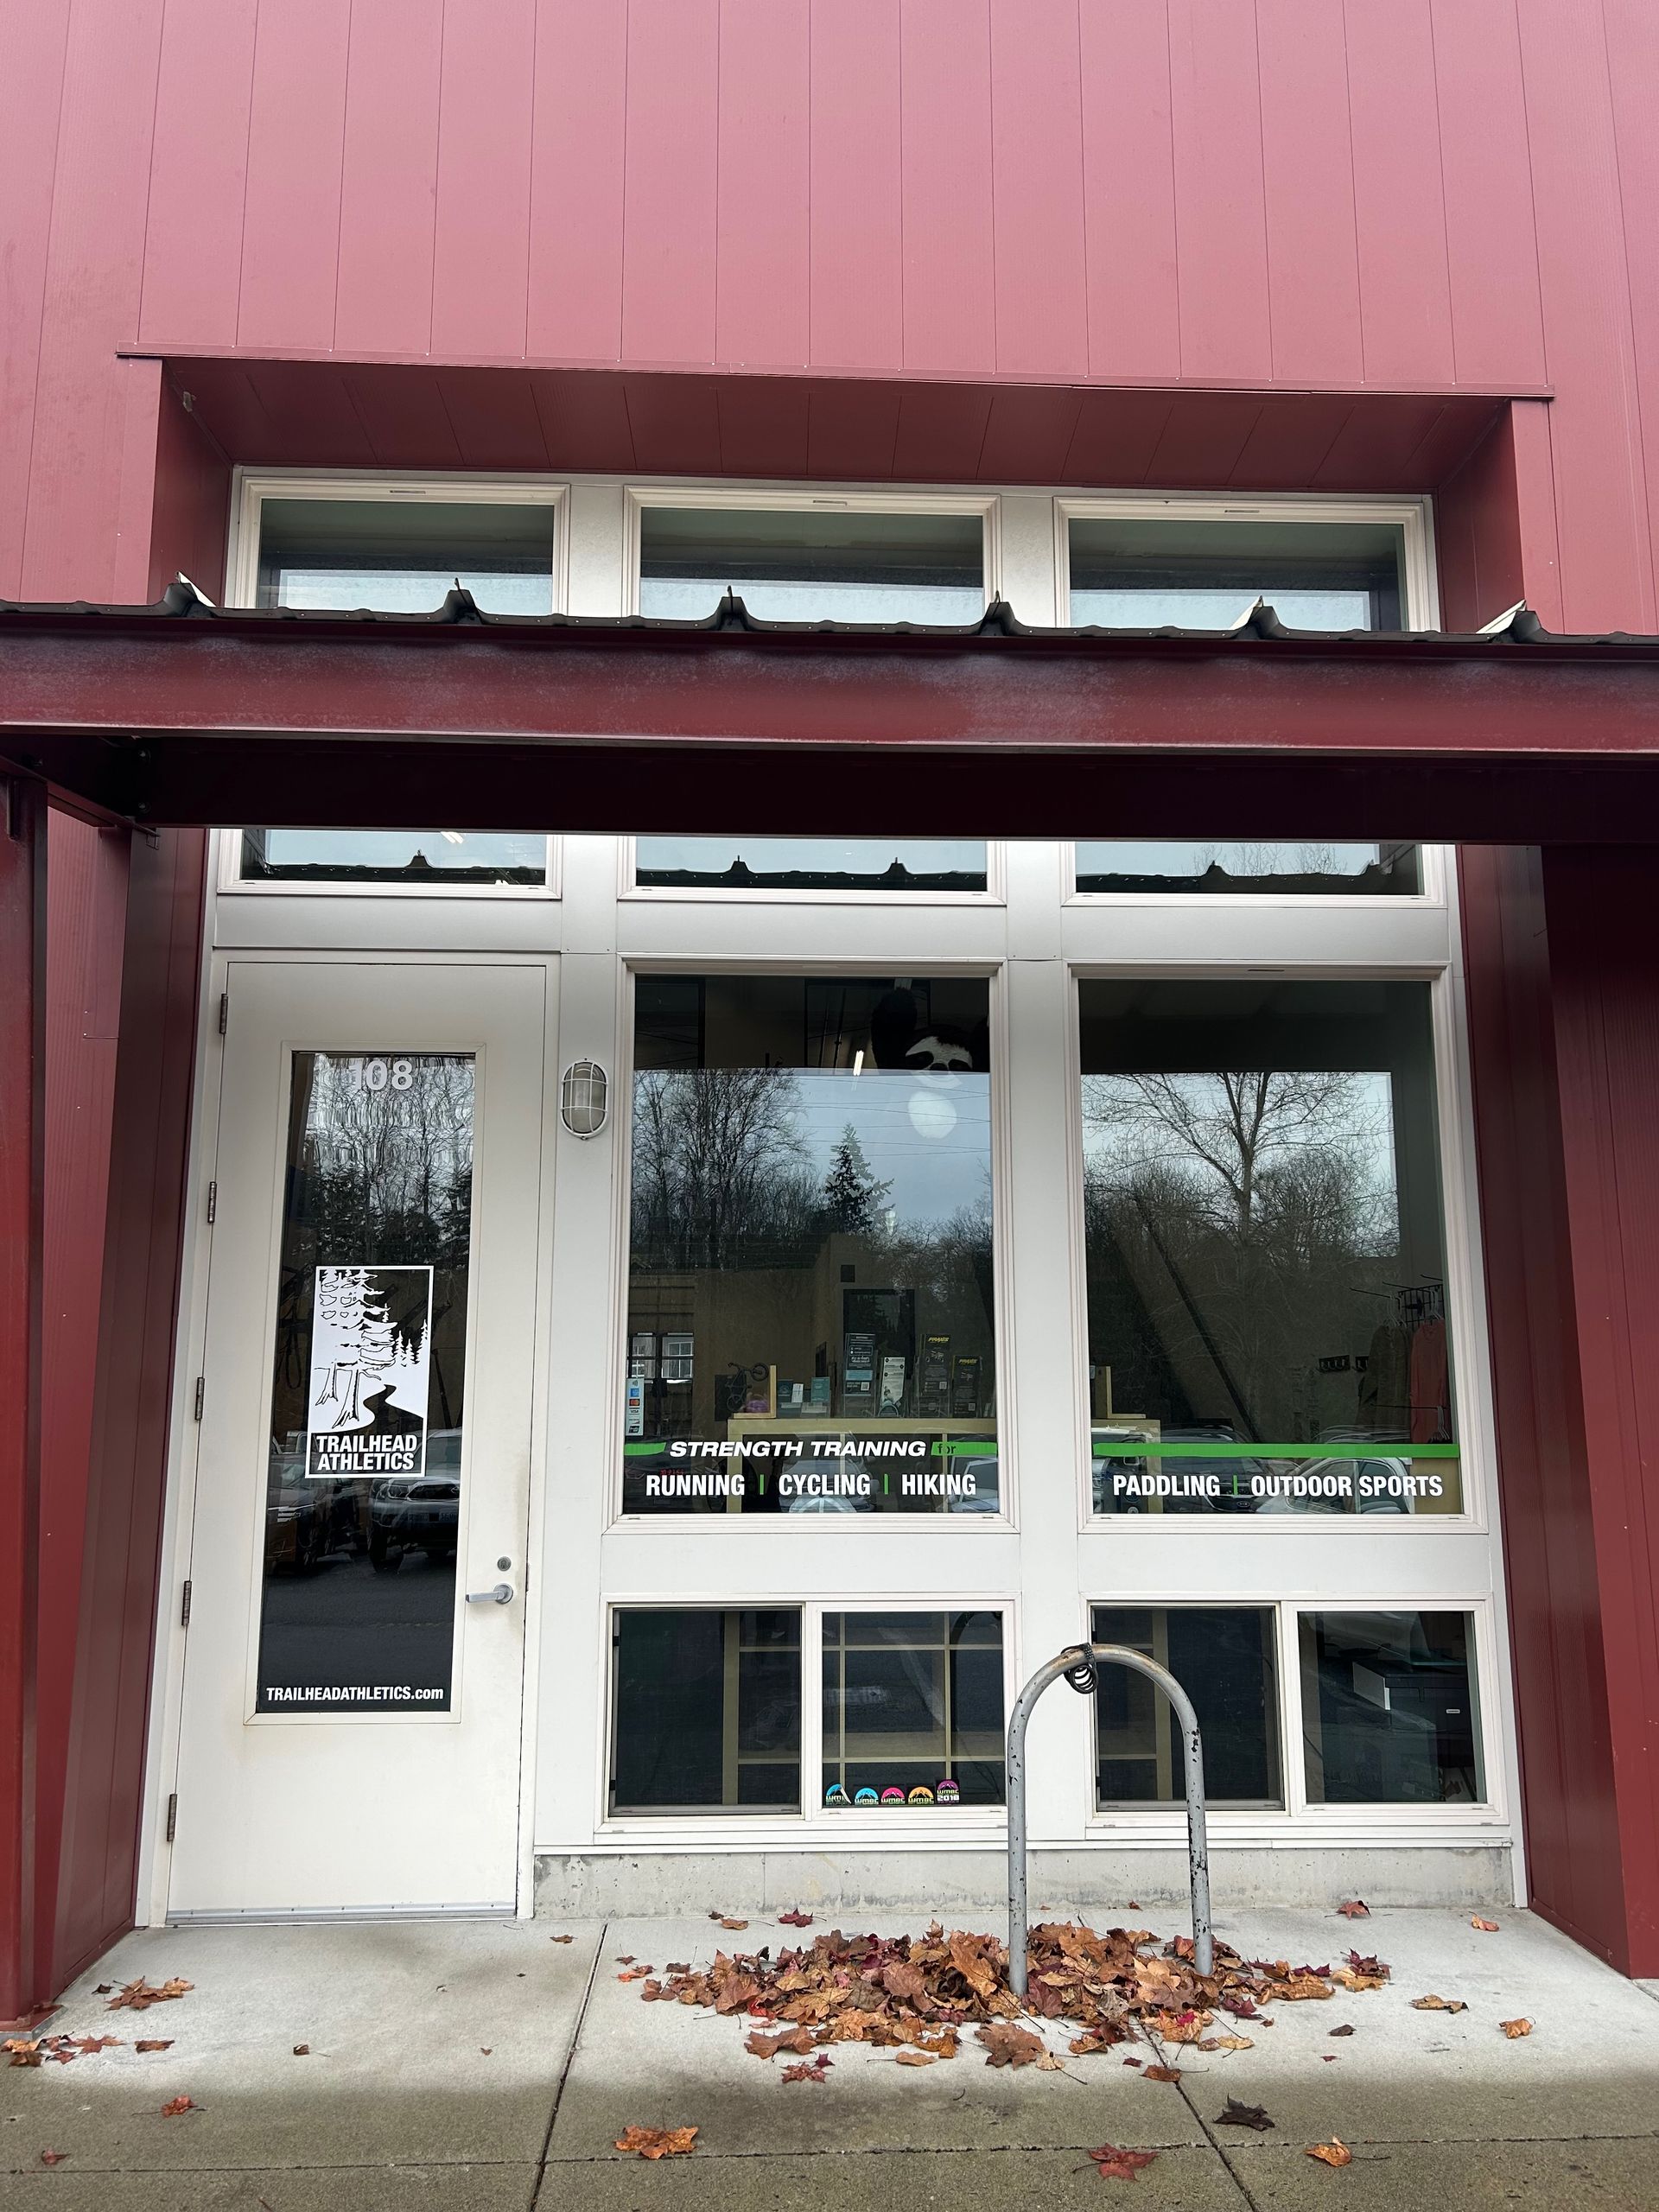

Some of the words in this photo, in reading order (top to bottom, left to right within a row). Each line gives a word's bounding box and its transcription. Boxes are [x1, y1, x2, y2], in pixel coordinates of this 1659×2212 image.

[348, 1060, 413, 1090] 108
[315, 1435, 417, 1453] TRAILHEAD
[670, 1440, 804, 1458] STRENGTH
[810, 1440, 926, 1457] TRAINING
[938, 1443, 957, 1454] for
[316, 1452, 415, 1471] ATHLETICS
[645, 1474, 745, 1496] RUNNING
[779, 1474, 871, 1496] CYCLING
[901, 1474, 976, 1497] HIKING
[1113, 1475, 1221, 1497] PADDLING
[1251, 1476, 1353, 1497] OUTDOOR
[1359, 1475, 1443, 1497] SPORTS
[266, 1686, 444, 1701] TRAILHEADATHLETICS.com
